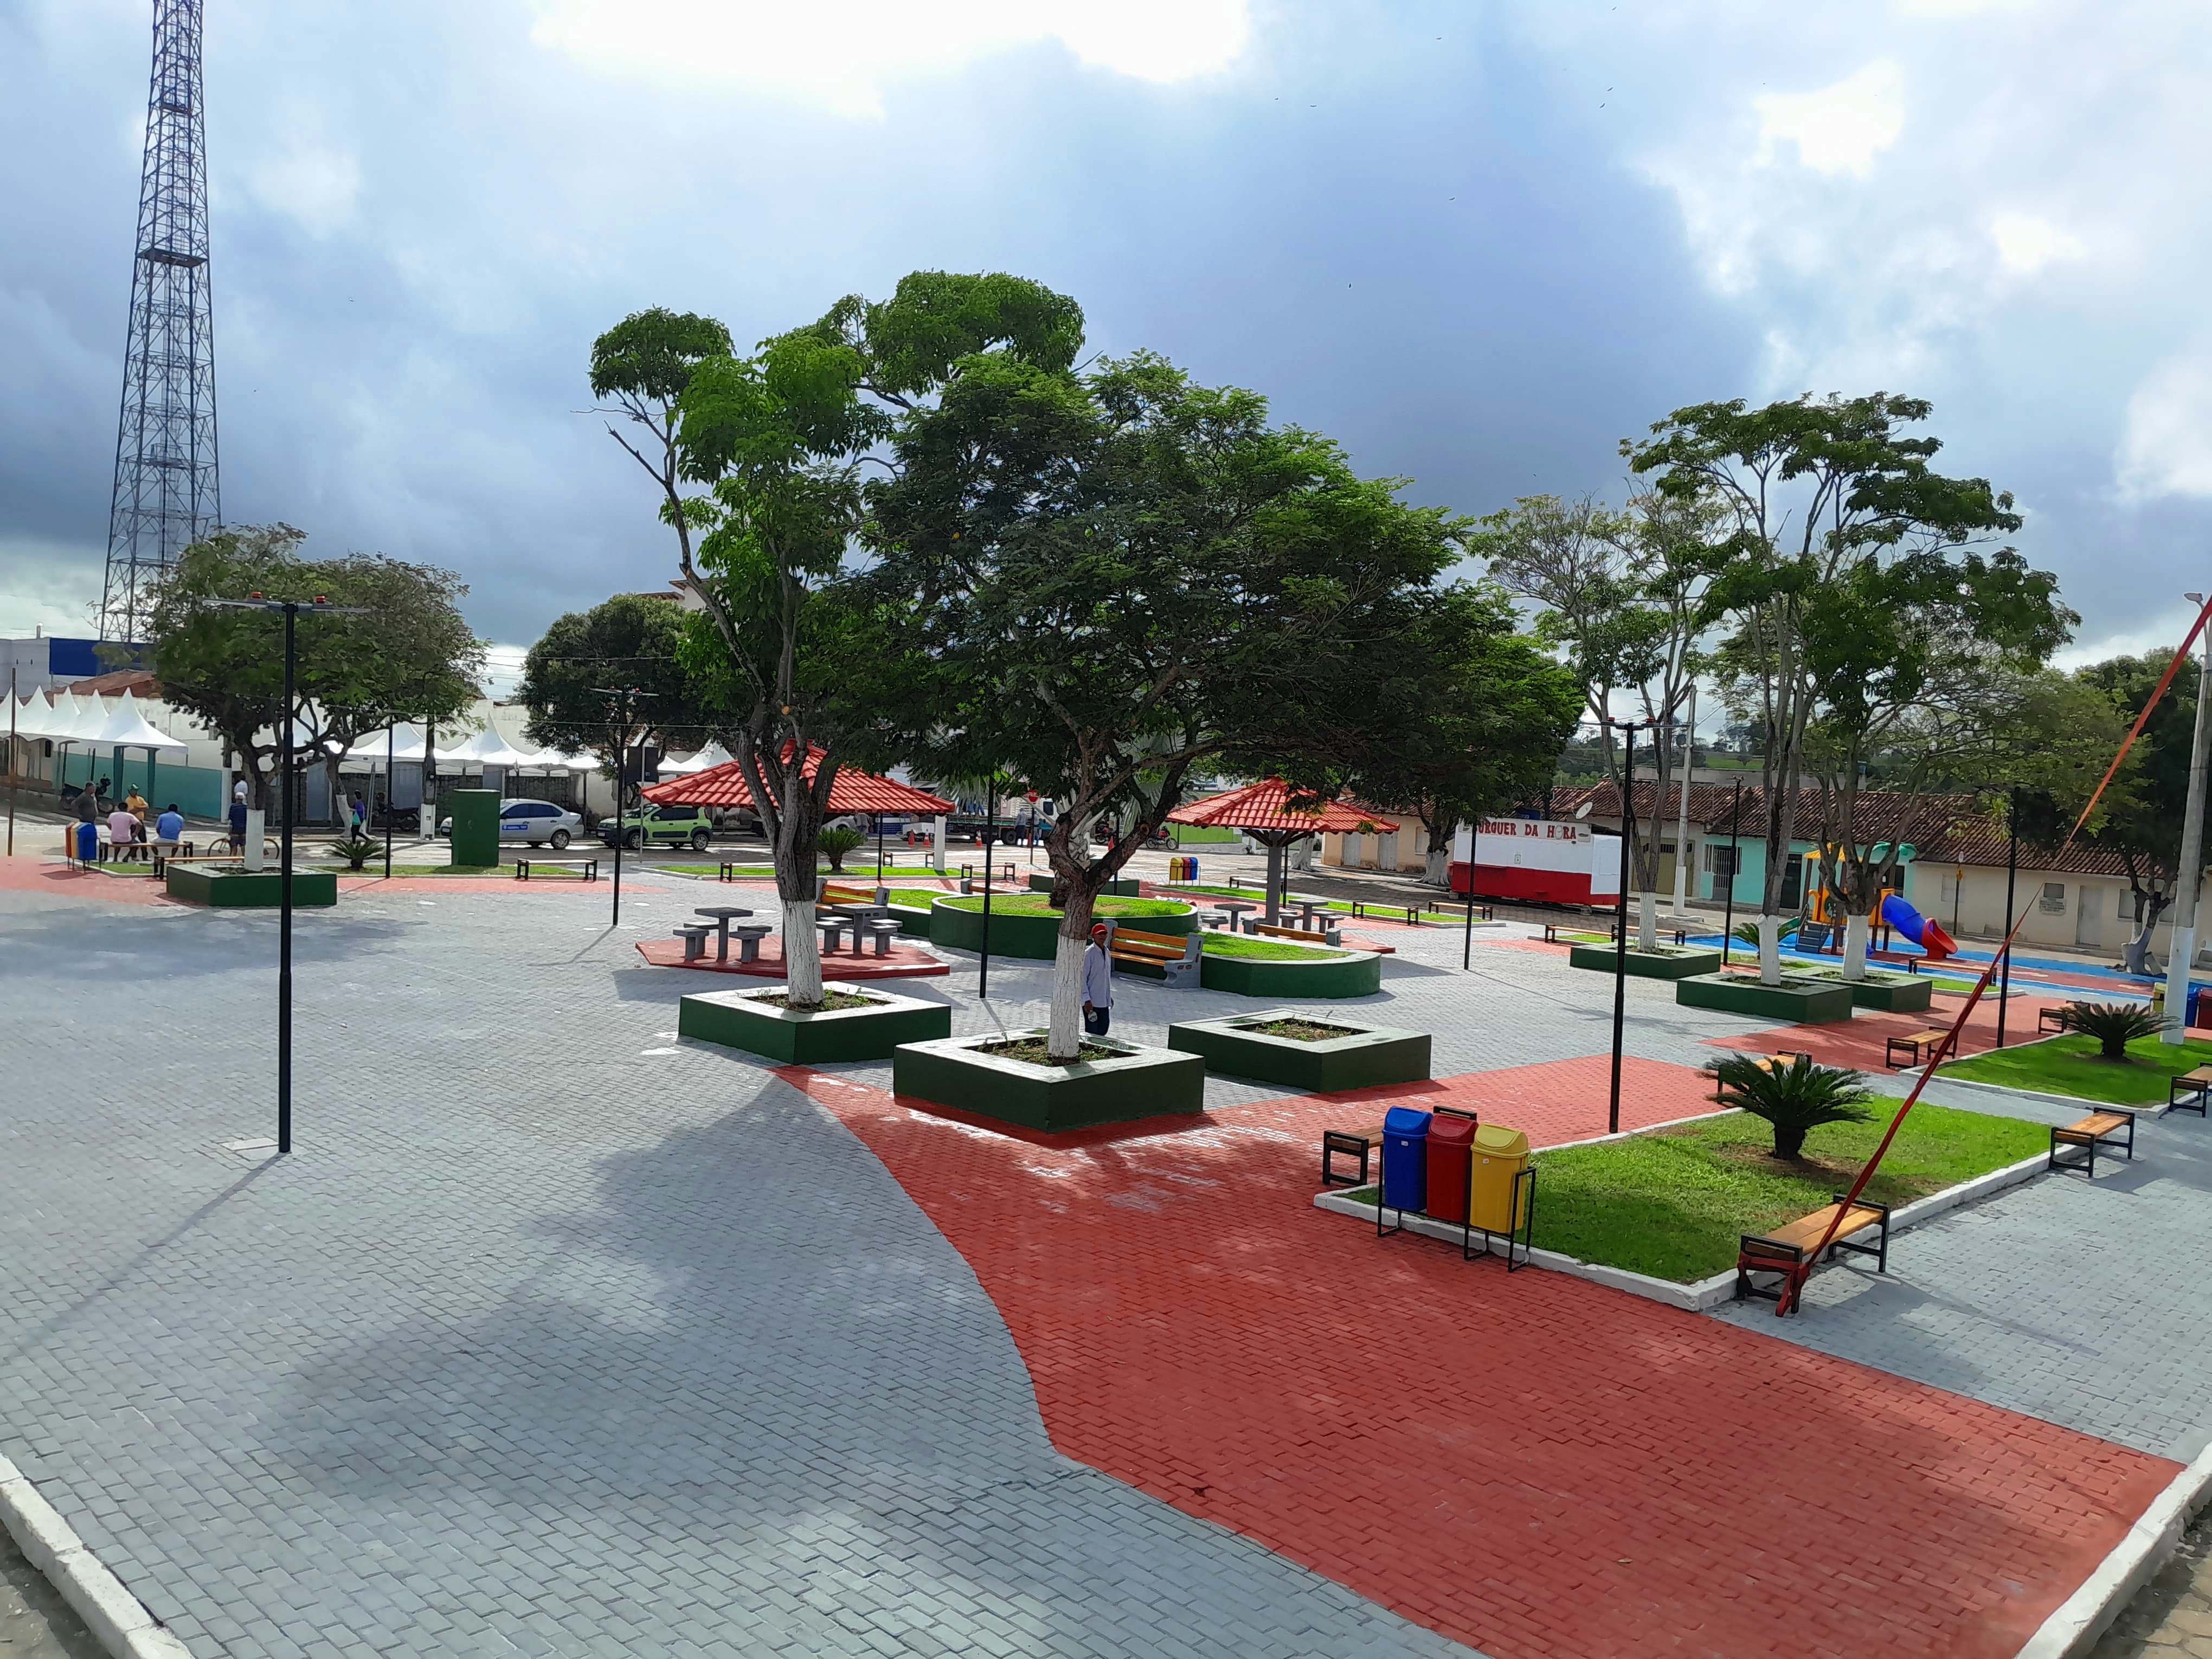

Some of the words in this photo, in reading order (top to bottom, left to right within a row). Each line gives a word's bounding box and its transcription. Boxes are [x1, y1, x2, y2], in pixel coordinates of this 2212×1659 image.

[1475, 821, 1516, 835] URGUER
[1525, 824, 1539, 837] DA
[1546, 825, 1577, 839] HORA
